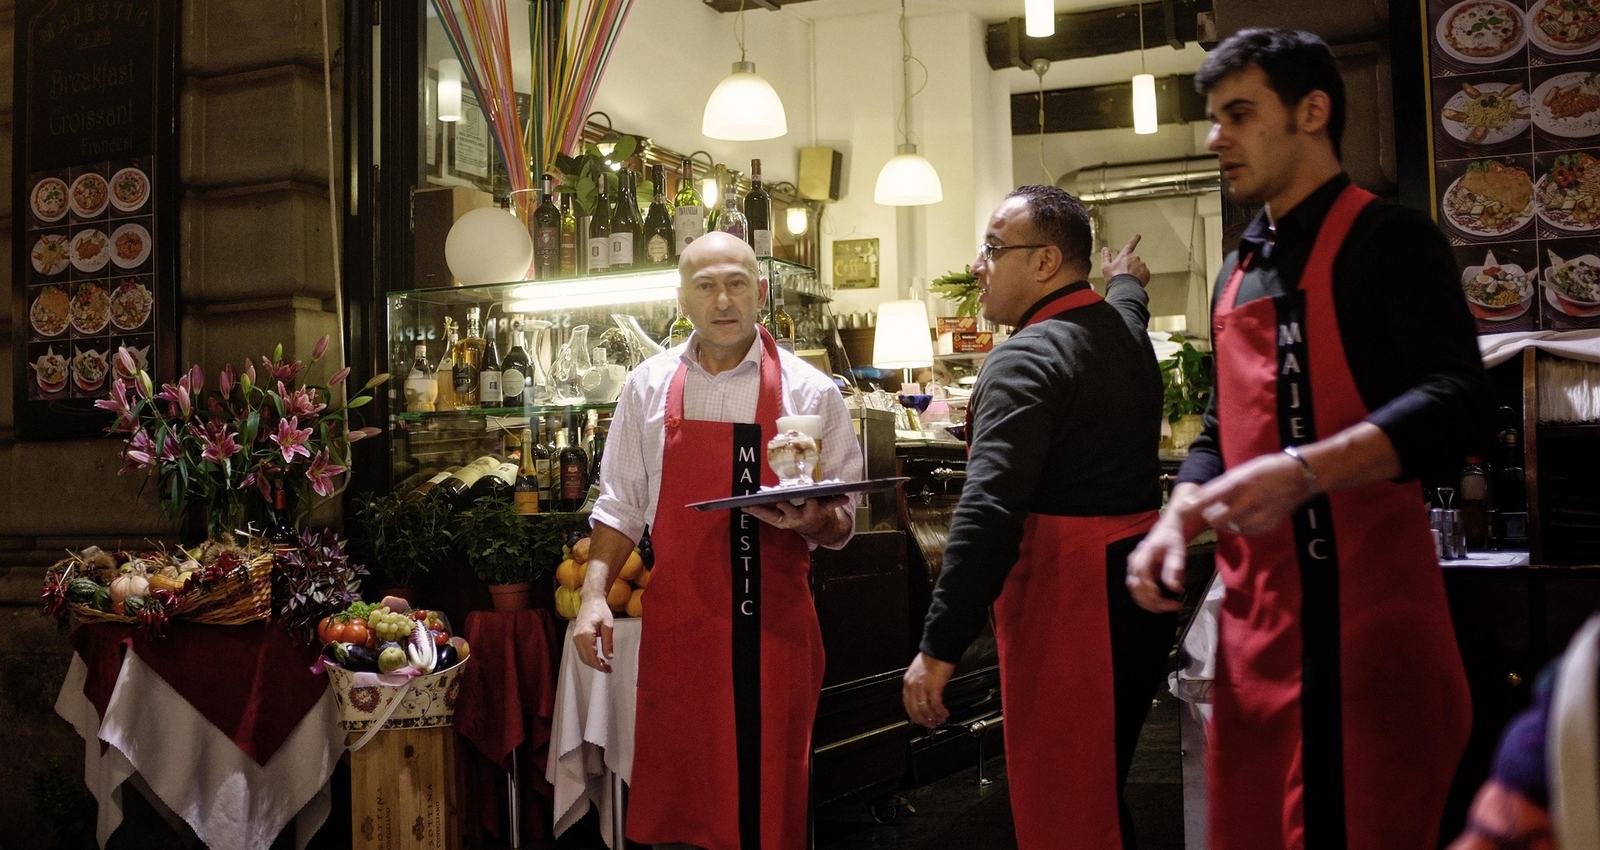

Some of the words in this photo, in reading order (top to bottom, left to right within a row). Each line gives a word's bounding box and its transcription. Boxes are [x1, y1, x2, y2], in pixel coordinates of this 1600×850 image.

[50, 59, 134, 99] Breakfast
[49, 96, 133, 136] Croissant
[1278, 321, 1328, 560] MAJEIC
[426, 783, 435, 847] SOTTINA
